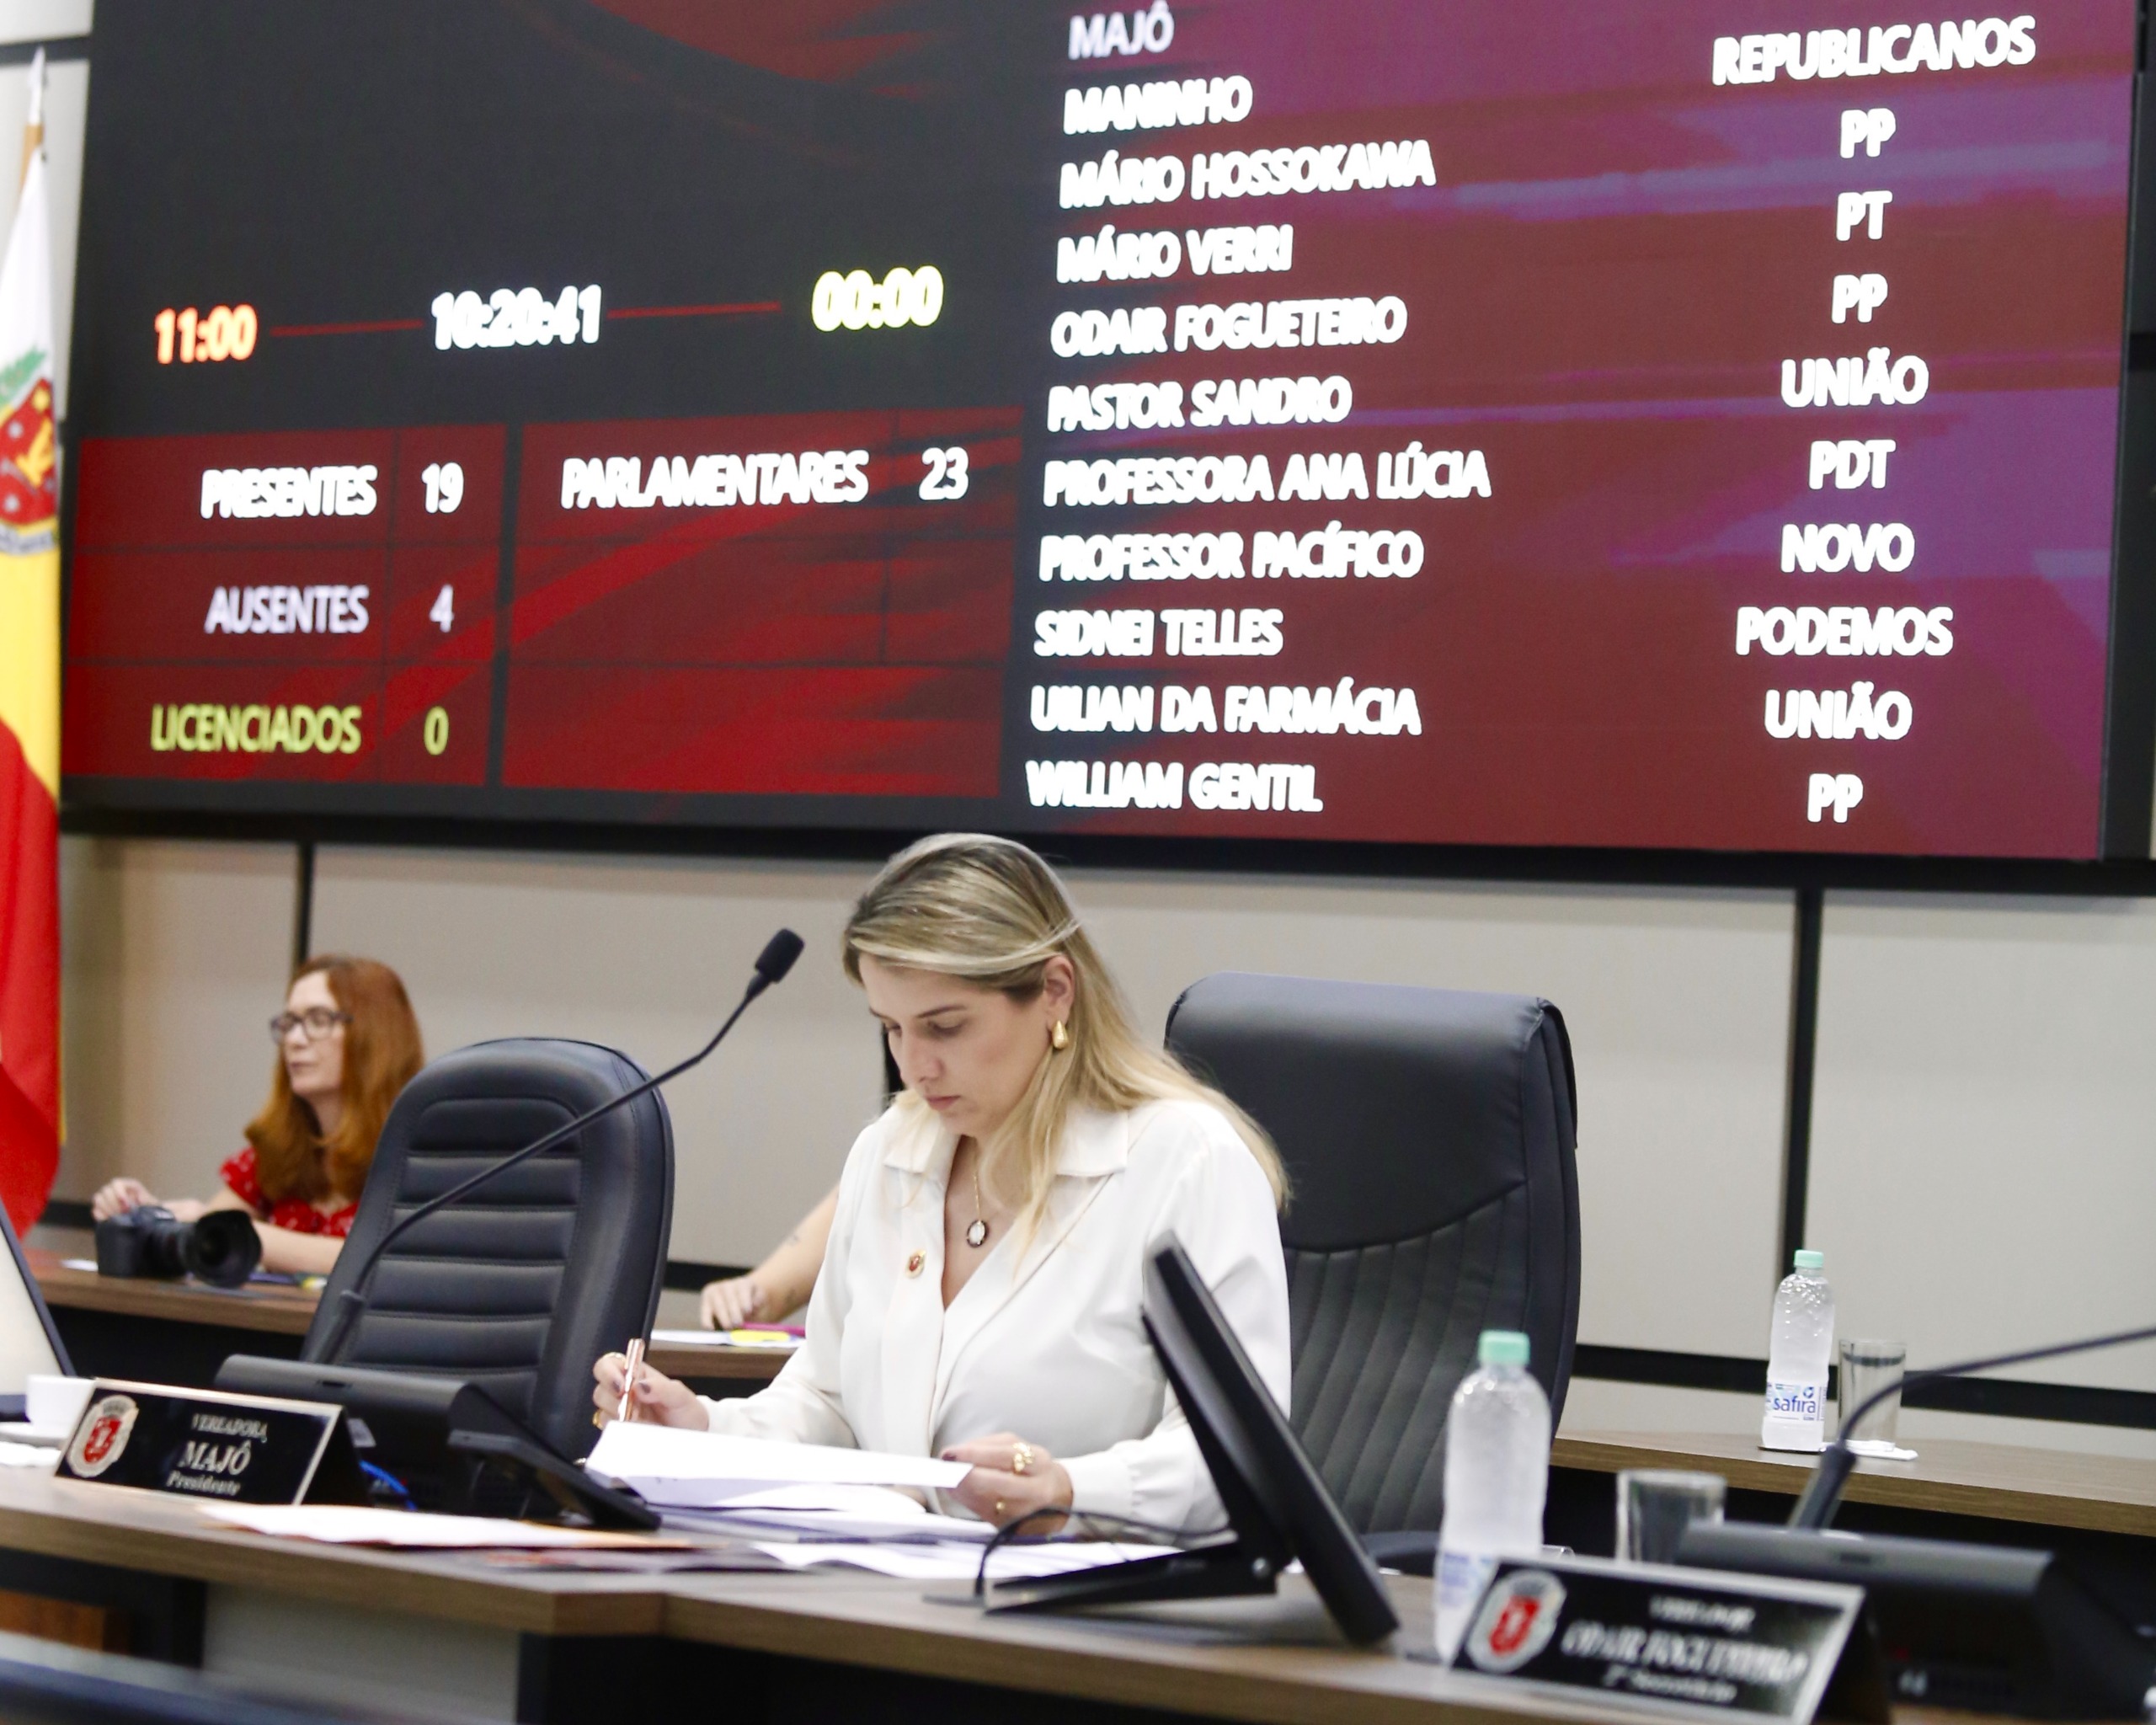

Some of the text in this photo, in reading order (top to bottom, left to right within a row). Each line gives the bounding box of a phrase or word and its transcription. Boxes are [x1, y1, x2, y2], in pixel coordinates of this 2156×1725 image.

[1068, 0, 1174, 59] MAJÔ
[1712, 14, 2036, 86] REPUBLICANOS
[1063, 75, 1253, 135] MANINHO
[1839, 108, 1897, 159] PP
[1059, 139, 1437, 209] MÁRIO HOSSOKAWA
[1836, 190, 1893, 242] PT
[1056, 223, 1294, 284] MÁRIO VERRI
[811, 265, 944, 332] 00:00
[1050, 296, 1408, 358] ODAIR FOGUETEIRO
[1831, 273, 1888, 324] PP
[155, 303, 258, 364] 11:00
[1047, 375, 1353, 433] PASTOR SANDRO
[1780, 346, 1929, 408] UNIÃO
[200, 462, 464, 519] PRESENTES 19
[561, 446, 969, 510] PARLAMENTARES 23
[1043, 441, 1492, 507] PROFESSORA ANA LÚCIA
[1808, 439, 1897, 490] PDT
[1038, 520, 1424, 582] PROFESSOR PACÍFICO
[1780, 522, 1915, 573] NOVO
[204, 585, 453, 633] AUSENTES 4
[1033, 608, 1283, 657] SIDNEI TELLES
[1735, 606, 1954, 656] PODEMOS
[151, 704, 449, 755] LICENCIADOS 0
[1030, 676, 1422, 735] UILIAN DA FARMÁCIA
[1764, 681, 1913, 740] UNIÃO
[1025, 760, 1324, 812] WILLIAM GENTIL
[1807, 773, 1864, 823] PP
[1773, 1395, 1817, 1414] safira
[176, 1439, 252, 1476] MAJÔ
